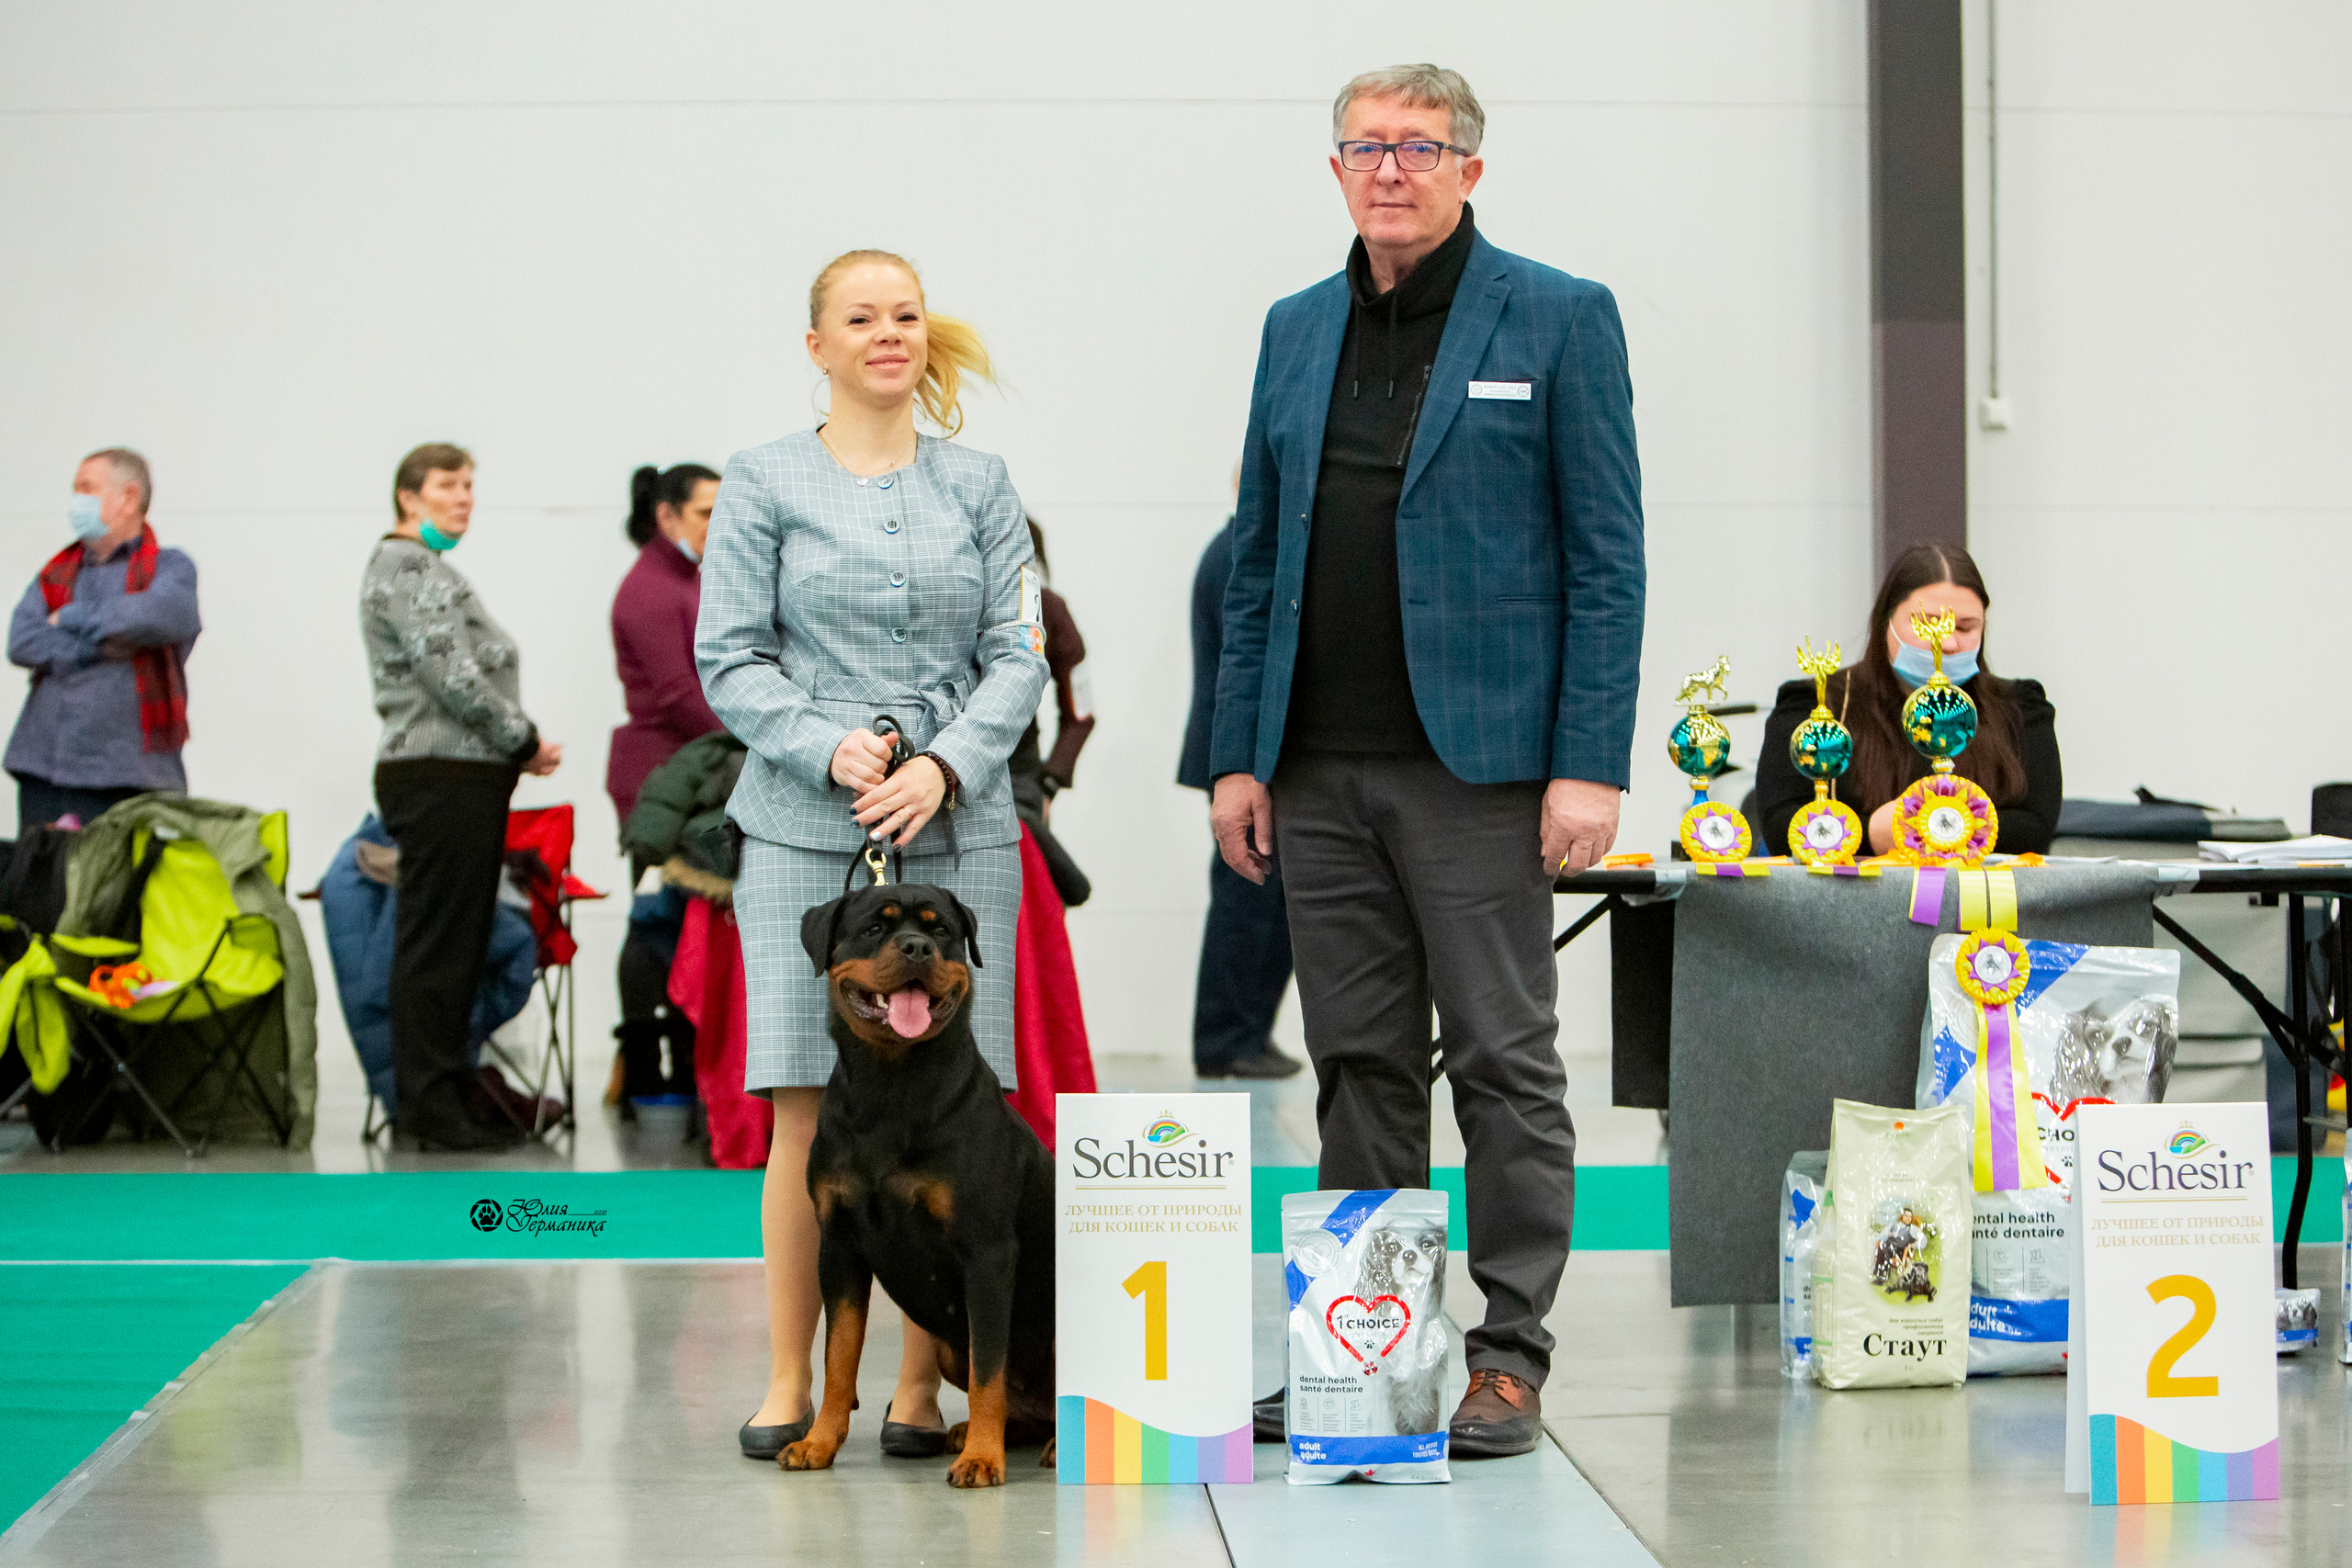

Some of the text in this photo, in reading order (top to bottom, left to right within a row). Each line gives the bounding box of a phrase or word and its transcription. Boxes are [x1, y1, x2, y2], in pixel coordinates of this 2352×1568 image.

[2037, 1126, 2075, 1141] CHO
[1072, 1137, 1234, 1179] Schesir
[2098, 1149, 2254, 1191] Schesir
[1065, 1204, 1242, 1217] ЛУЧШЕЕ ОТ ПРИРОДЫ
[1973, 1212, 2055, 1224] ental health
[2091, 1215, 2264, 1231] ЛУЧШЕЕ ОТ ПРИРОДЫ
[1069, 1221, 1238, 1235] ДЛЯ КОШЕК И СОБАК
[1972, 1225, 2064, 1239] nté dentaire
[2095, 1232, 2262, 1249] ДЛЯ КОШЕК И СОБАК
[1971, 1303, 1997, 1316] dult
[1121, 1260, 1168, 1381] 1
[1346, 1318, 1400, 1329] CHOICE
[1969, 1315, 2006, 1332] dulte
[2145, 1273, 2220, 1399] 2
[1863, 1333, 1947, 1361] Стаут
[1299, 1375, 1358, 1384] dental health
[1299, 1384, 1363, 1393] santé dentaire
[1299, 1441, 1321, 1451] adult
[1300, 1450, 1327, 1461] adulte
